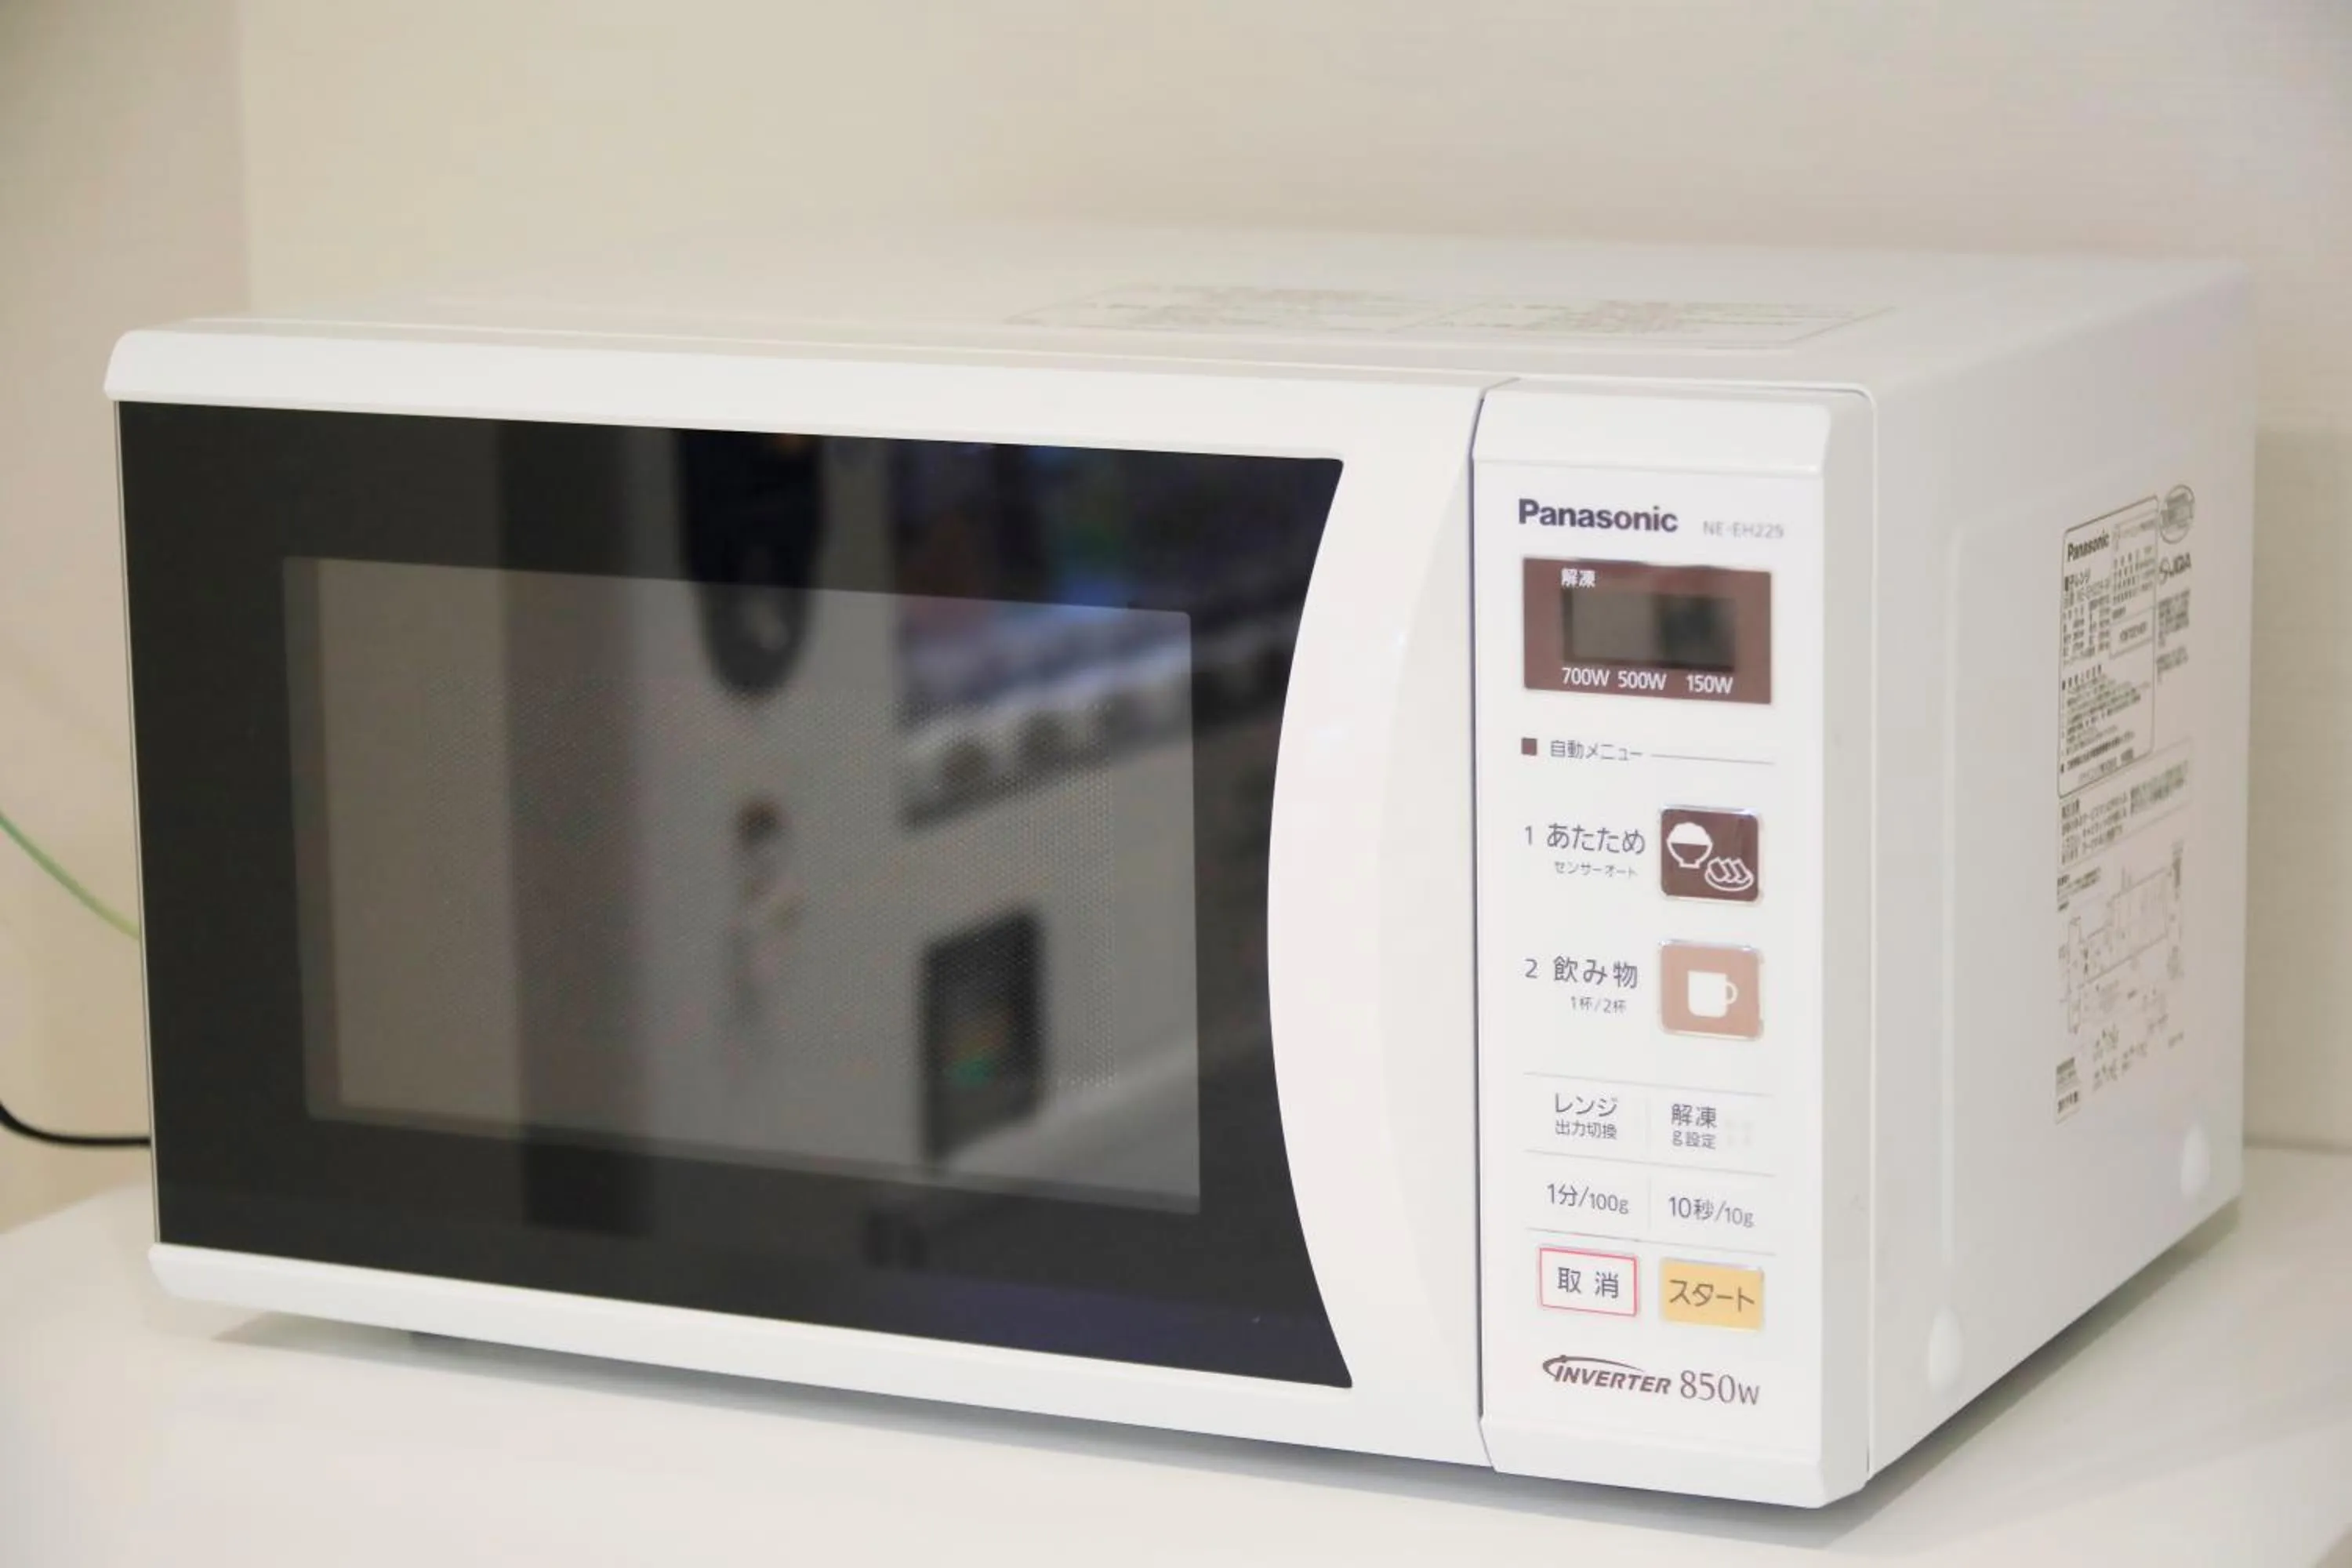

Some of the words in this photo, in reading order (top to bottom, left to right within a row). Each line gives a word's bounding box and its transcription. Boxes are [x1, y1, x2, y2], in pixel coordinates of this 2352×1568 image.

[1519, 498, 1679, 533] Panasonic
[1561, 567, 1596, 588] 解凍
[1561, 666, 1611, 688] 700W
[1617, 670, 1668, 691] 500W
[1686, 674, 1733, 695] 150W
[1550, 739, 1643, 761] 自動メニュー
[1524, 825, 1534, 846] 1
[1546, 822, 1646, 855] あたため
[1554, 861, 1637, 878] センサーオート
[1524, 958, 1538, 979] 2
[1553, 955, 1639, 989] 飲み物
[1570, 995, 1627, 1014] 1杯/2杯
[1555, 1092, 1618, 1118] レンジ
[1671, 1102, 1718, 1129] 解凍
[1555, 1120, 1618, 1140] 出力切換
[1547, 1183, 1630, 1215] 1分/100g
[1668, 1196, 1755, 1229] 10秒/10g
[1668, 1278, 1755, 1312] スタート
[1543, 1355, 1672, 1395] INVERTER
[1679, 1370, 1761, 1406] 850W
